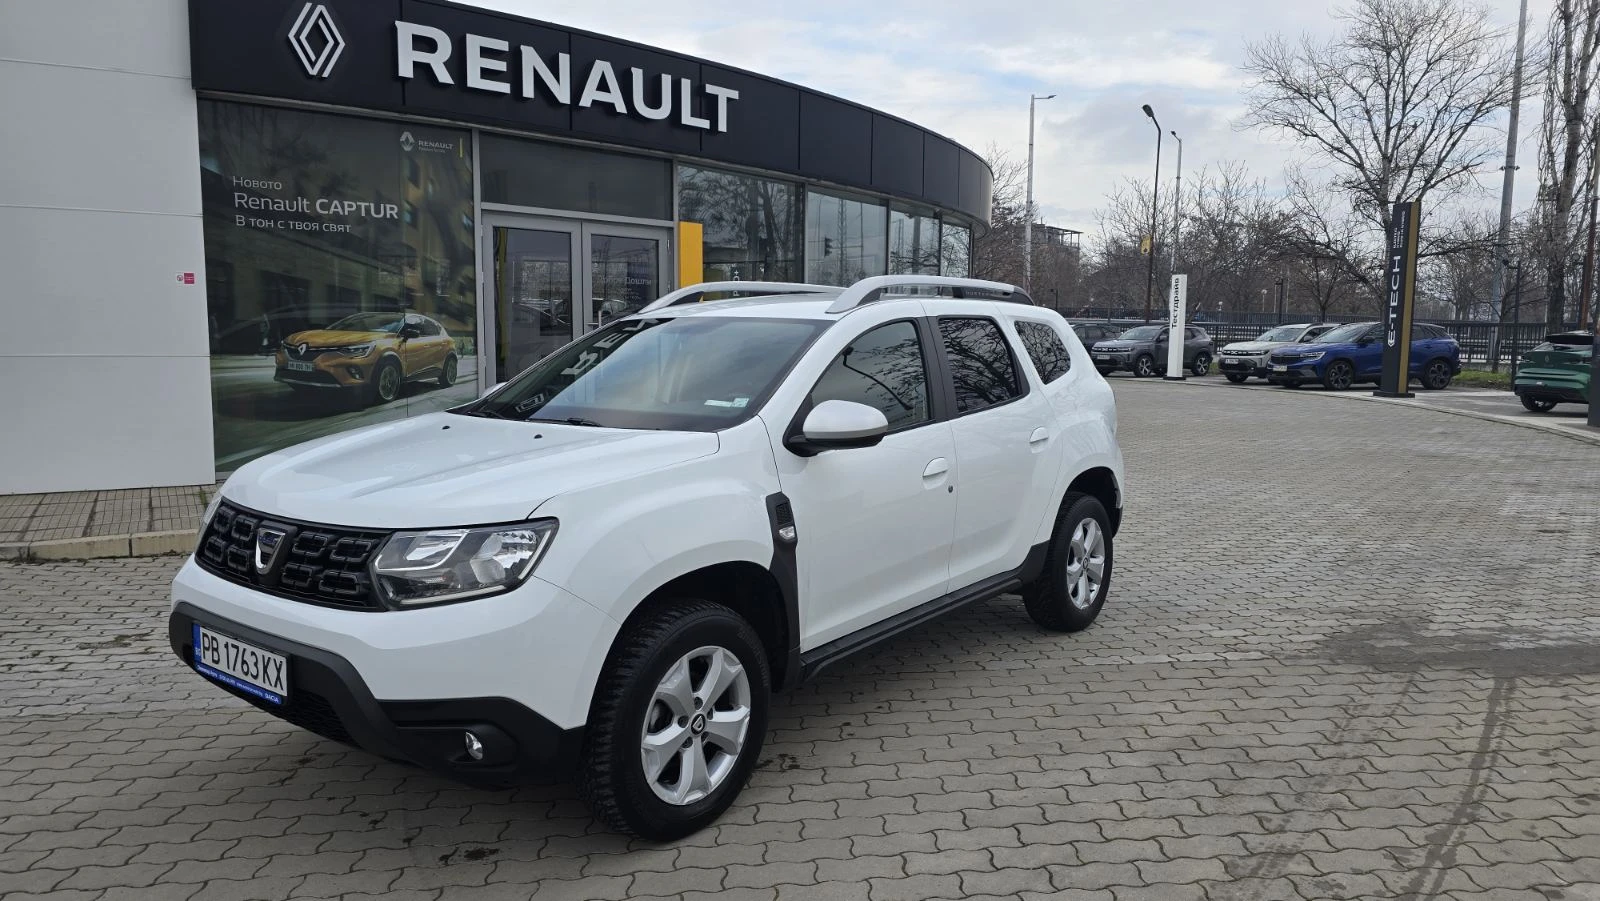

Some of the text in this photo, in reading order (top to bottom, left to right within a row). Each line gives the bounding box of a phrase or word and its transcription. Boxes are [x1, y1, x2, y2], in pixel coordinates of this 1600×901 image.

[394, 20, 739, 133] RENAULT
[419, 140, 453, 150] RENAULT
[233, 176, 282, 190] Новото
[234, 192, 399, 219] Renault CAPTUR
[236, 215, 352, 233] В тон с твоя свят
[1387, 255, 1401, 348] E-TECH
[202, 632, 284, 691] PB 1763 KX
